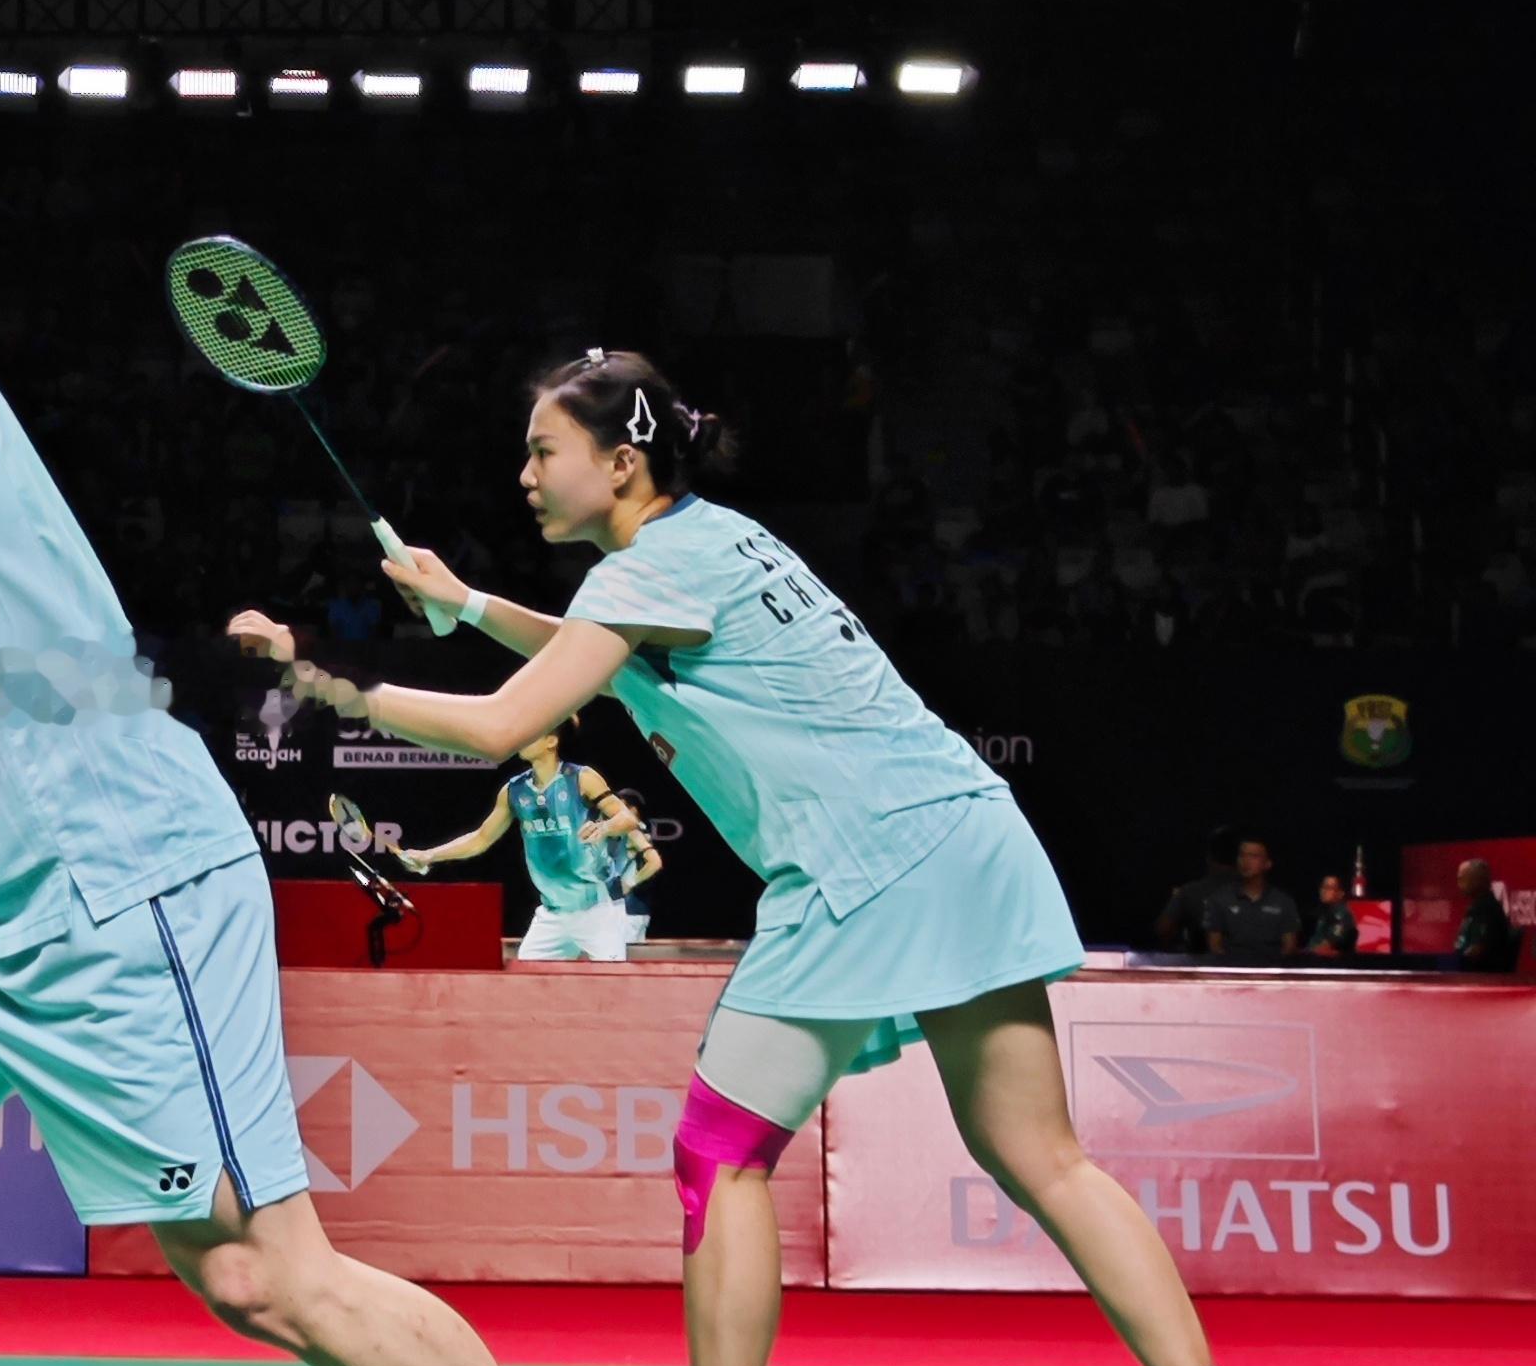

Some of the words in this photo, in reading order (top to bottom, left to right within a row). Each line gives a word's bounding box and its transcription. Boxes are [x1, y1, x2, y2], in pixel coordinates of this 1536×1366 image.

[343, 751, 394, 764] BENAR
[399, 751, 450, 764] BENAR
[454, 751, 490, 765] KOP
[452, 1082, 679, 1173] HSB
[950, 1177, 1451, 1256] DHATSU
